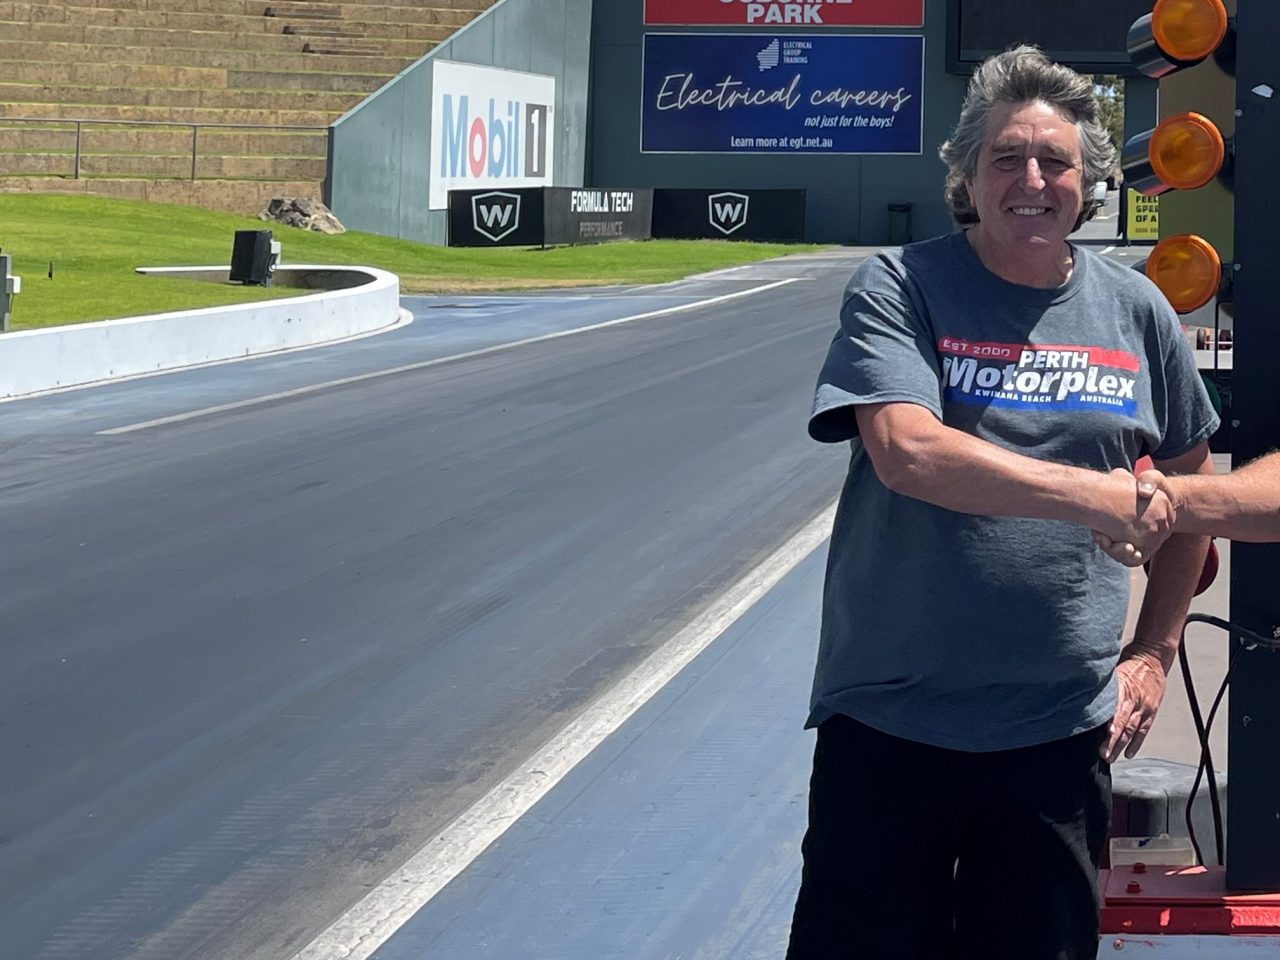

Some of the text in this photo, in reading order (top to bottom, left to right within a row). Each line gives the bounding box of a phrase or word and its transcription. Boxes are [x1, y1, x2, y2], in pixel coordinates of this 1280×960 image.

[747, 4, 823, 24] PARK
[656, 73, 912, 112] Electrical careers
[804, 115, 894, 129] not just for the boys!
[440, 94, 543, 178] Mobil 1
[731, 136, 833, 149] Learn more at egt.net.au
[571, 191, 634, 212] FORMULA TECH
[1136, 205, 1160, 213] SPEE
[943, 339, 1010, 357] EST 2000
[1019, 350, 1089, 369] PERTH
[941, 356, 1136, 400] Motorplex
[1021, 394, 1051, 403] BEACH
[1080, 394, 1124, 406] AUSTRALIA
